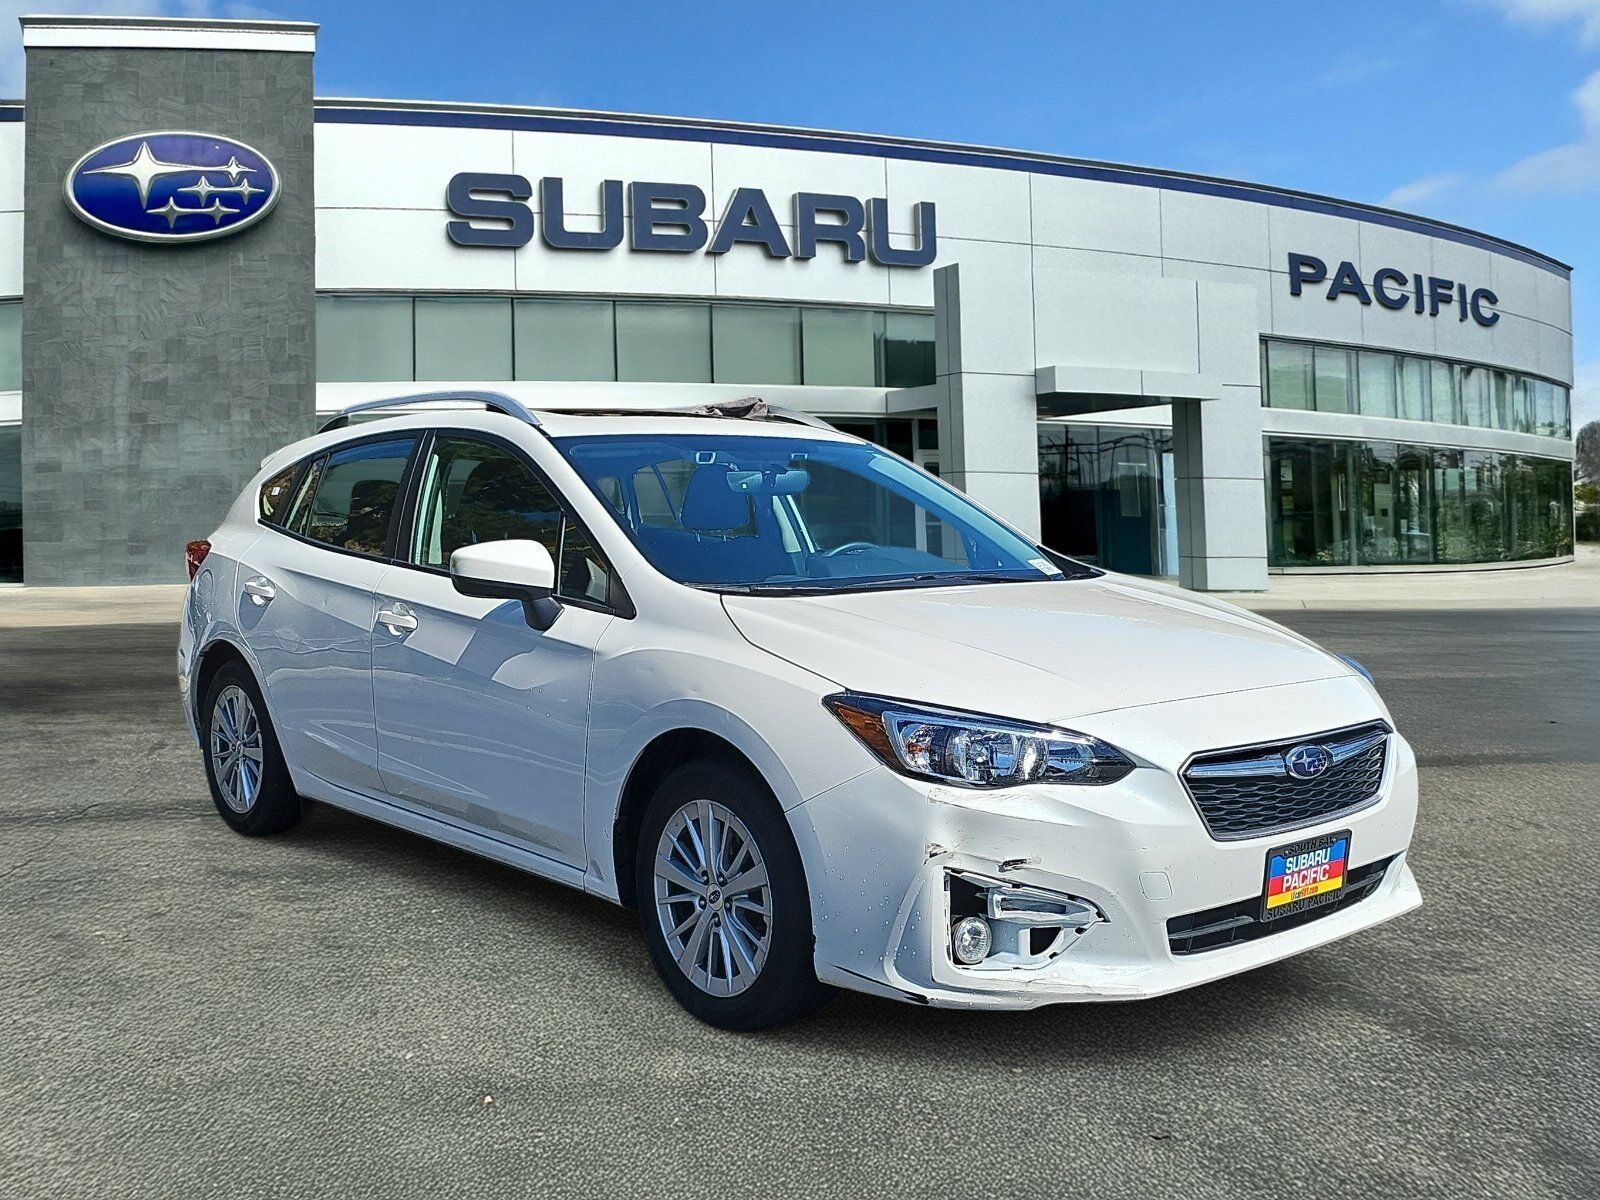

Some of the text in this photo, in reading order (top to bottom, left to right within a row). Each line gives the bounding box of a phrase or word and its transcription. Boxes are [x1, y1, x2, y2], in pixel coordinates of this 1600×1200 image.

[447, 172, 936, 268] SUBARU
[1288, 252, 1500, 327] PACIFIC
[1290, 838, 1317, 853] SOUTH
[1285, 847, 1331, 874] SUBARU
[1282, 864, 1330, 892] PACIFIC
[1267, 901, 1306, 920] SUBARU
